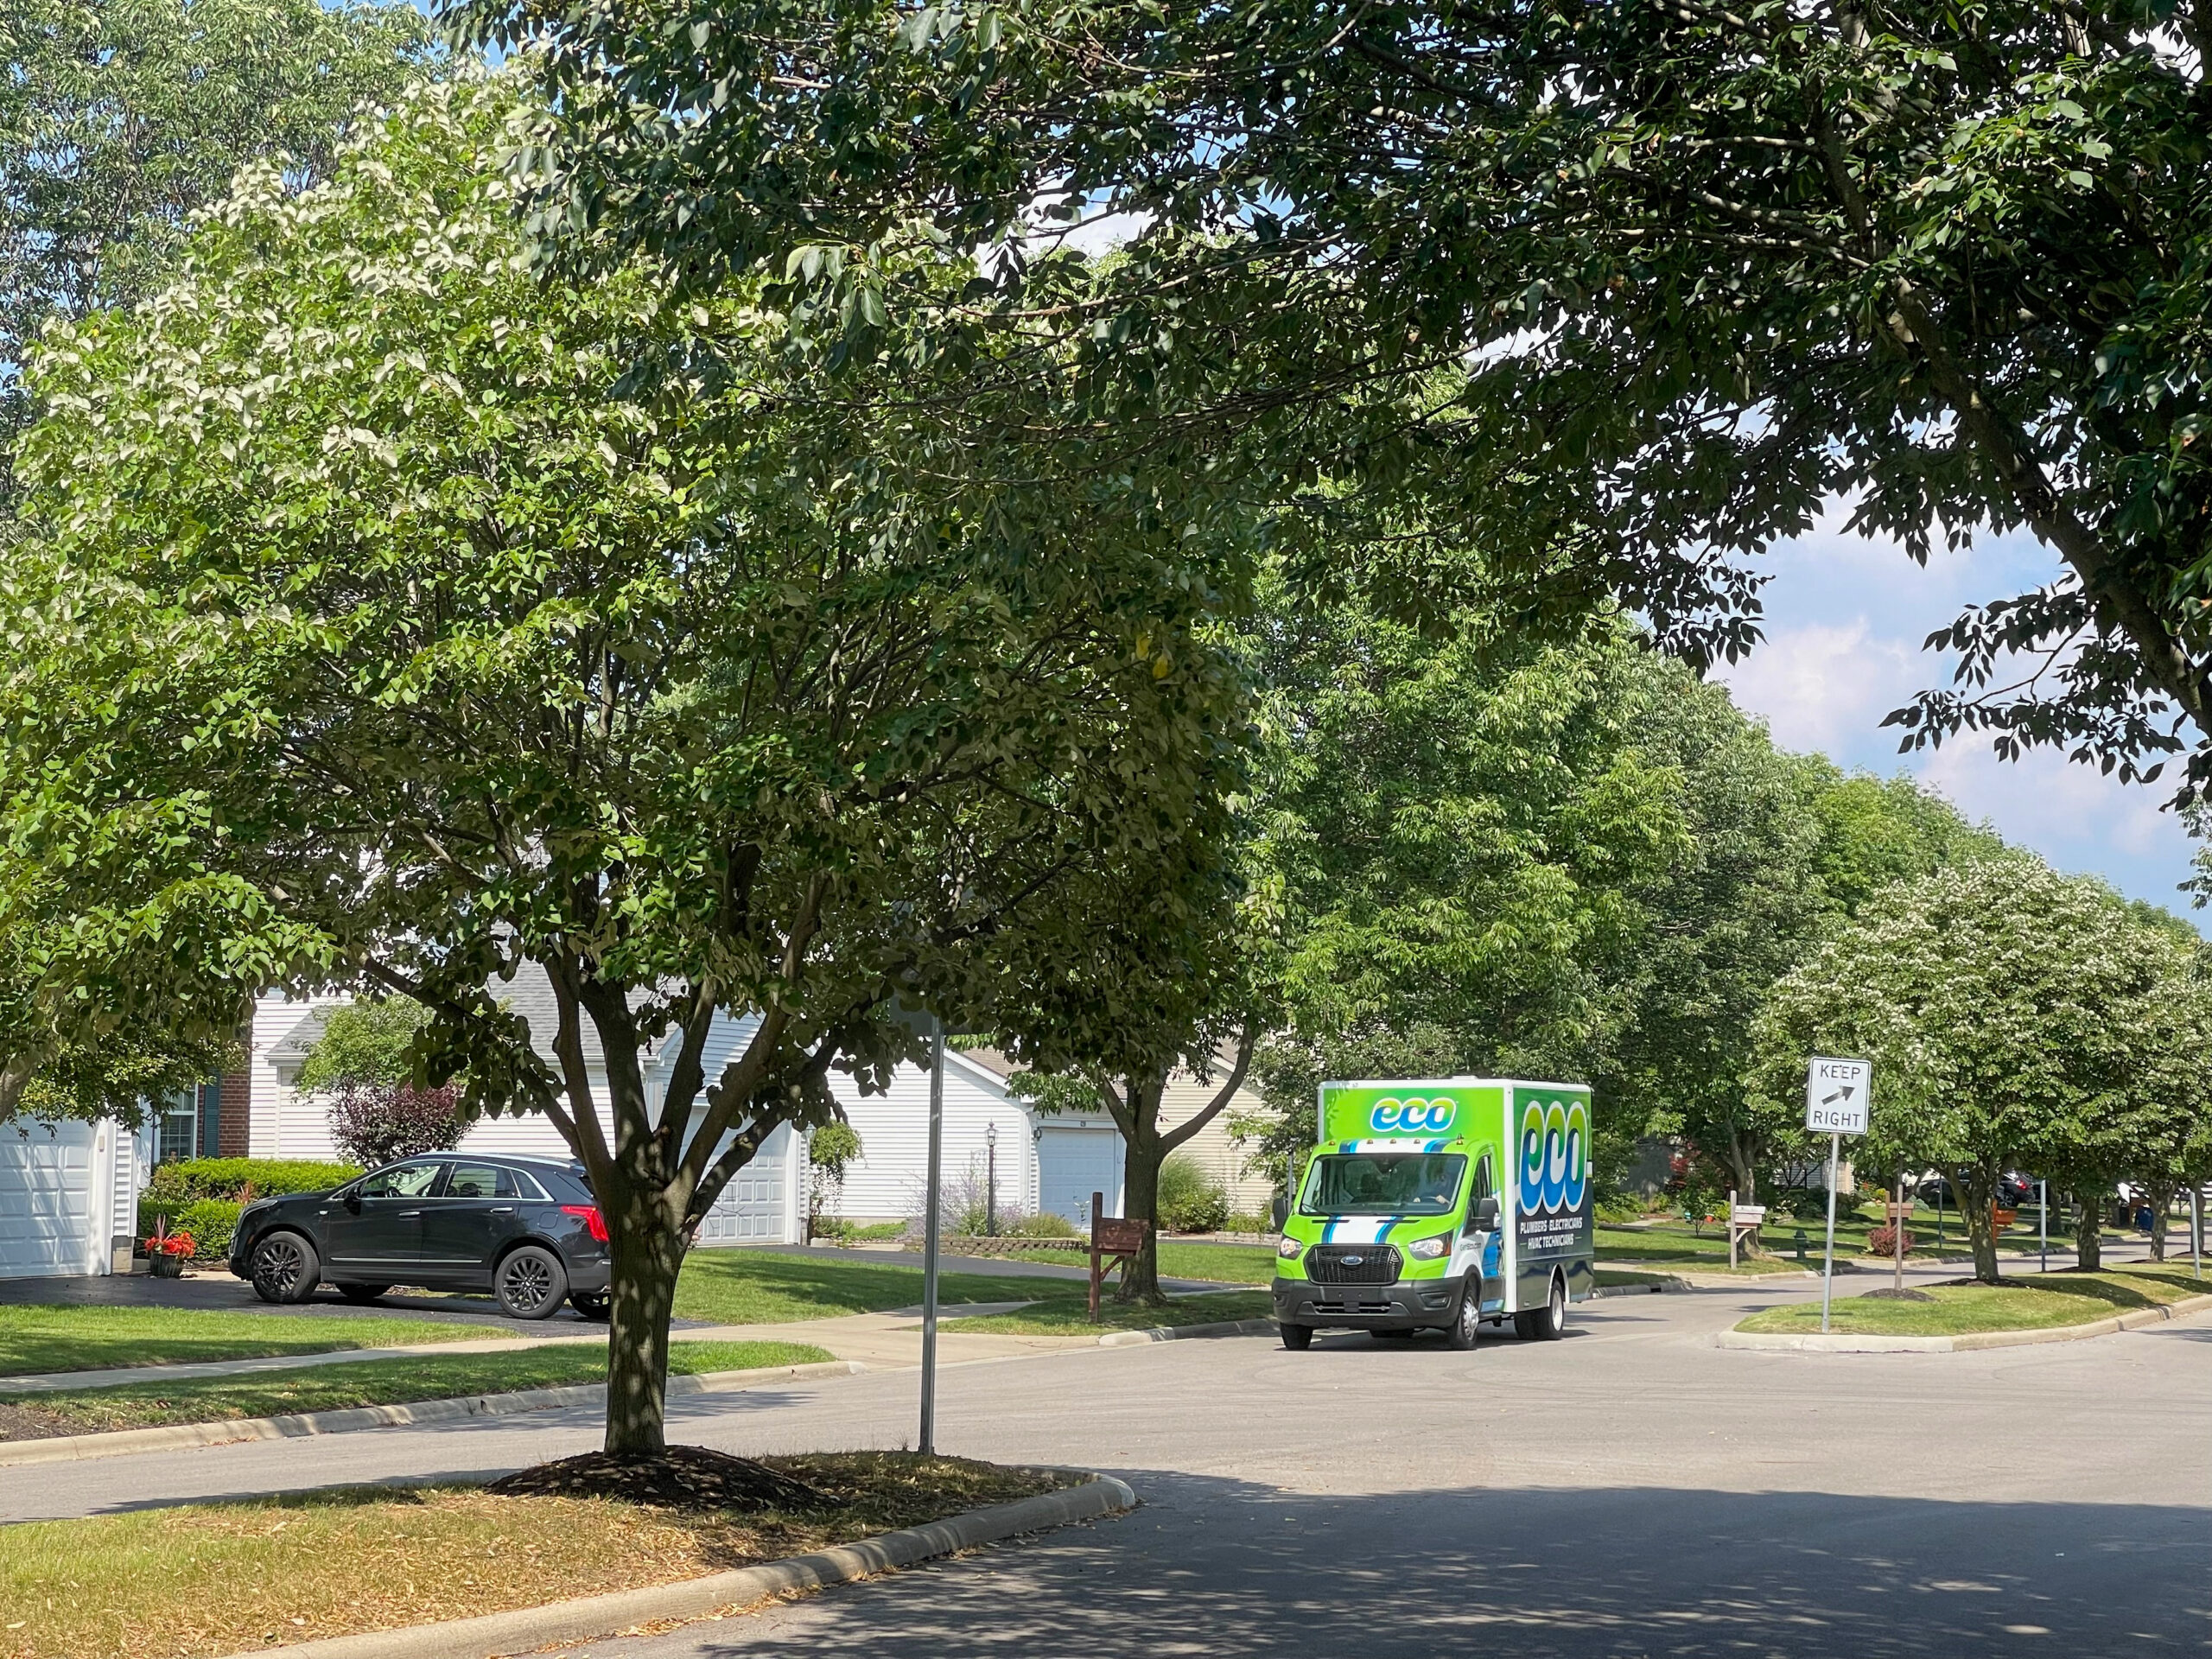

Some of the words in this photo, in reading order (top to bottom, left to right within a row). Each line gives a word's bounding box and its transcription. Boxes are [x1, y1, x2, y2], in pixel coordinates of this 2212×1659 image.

[1820, 1065, 1861, 1079] KEEP
[1370, 1096, 1457, 1132] eco
[1813, 1110, 1861, 1128] RIGHT
[1518, 1100, 1588, 1217] eco
[1520, 1219, 1548, 1235] PLUMBERS
[1548, 1217, 1583, 1231] ELECTRICIANS
[1528, 1236, 1542, 1250] HVAC
[1542, 1233, 1574, 1249] TECHNICIANS
